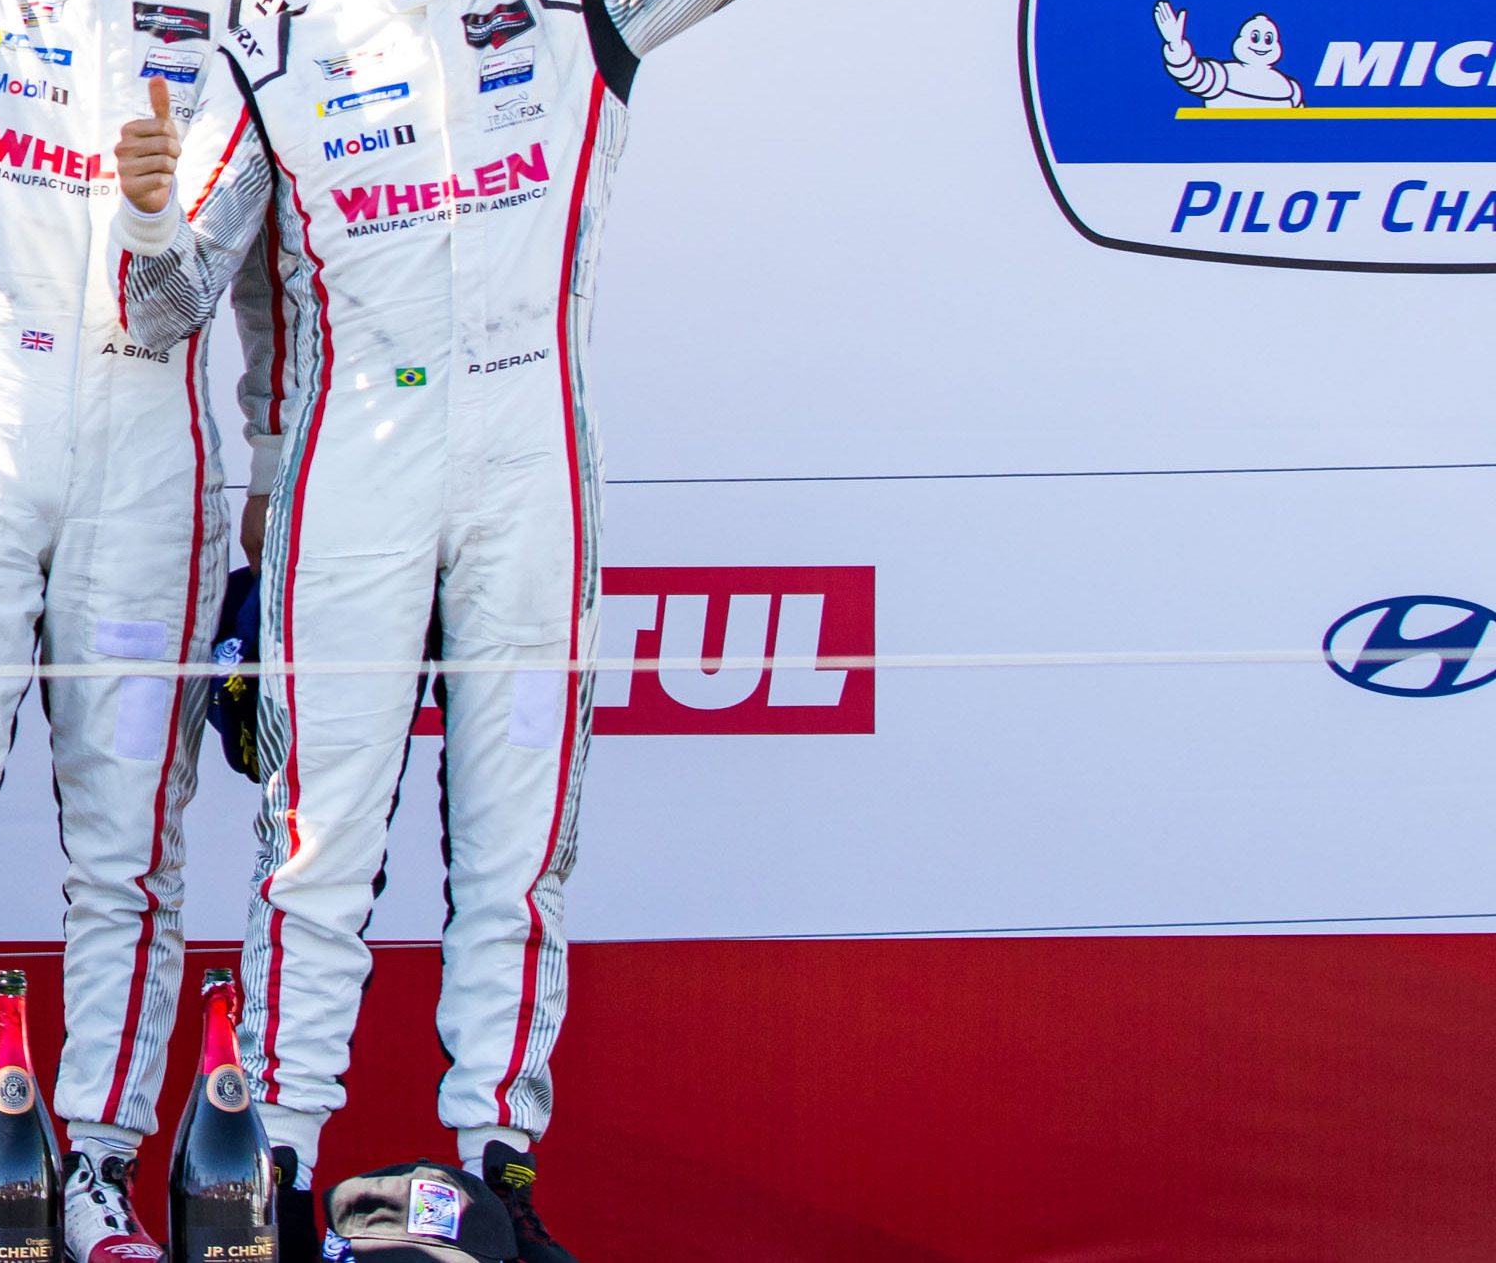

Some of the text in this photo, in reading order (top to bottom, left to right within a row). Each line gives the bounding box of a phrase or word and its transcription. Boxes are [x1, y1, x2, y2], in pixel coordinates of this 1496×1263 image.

[323, 129, 390, 162] Mobil
[329, 142, 550, 224] WHELEN
[475, 201, 488, 213] IN
[489, 186, 549, 211] AMERICA
[122, 344, 170, 364] SIMS
[204, 1246, 225, 1257] JP.
